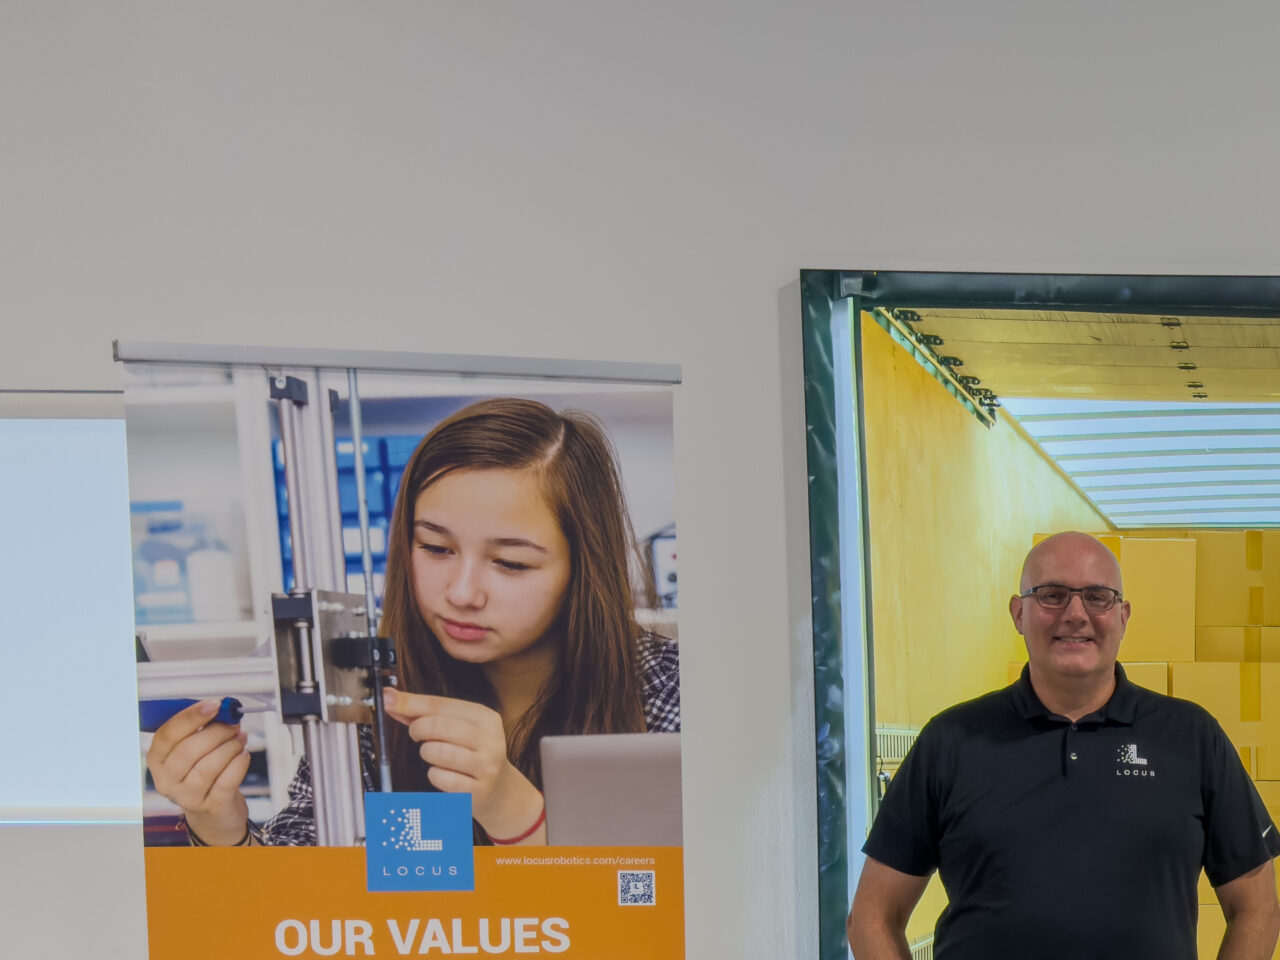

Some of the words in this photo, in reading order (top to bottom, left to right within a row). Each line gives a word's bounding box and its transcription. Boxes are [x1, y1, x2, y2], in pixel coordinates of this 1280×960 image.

[1116, 769, 1156, 777] LOCUS
[495, 855, 656, 866] www.locusrobotics.com/careers
[383, 866, 458, 877] LOCUS
[275, 918, 375, 957] OUR
[386, 917, 571, 956] VALUES
